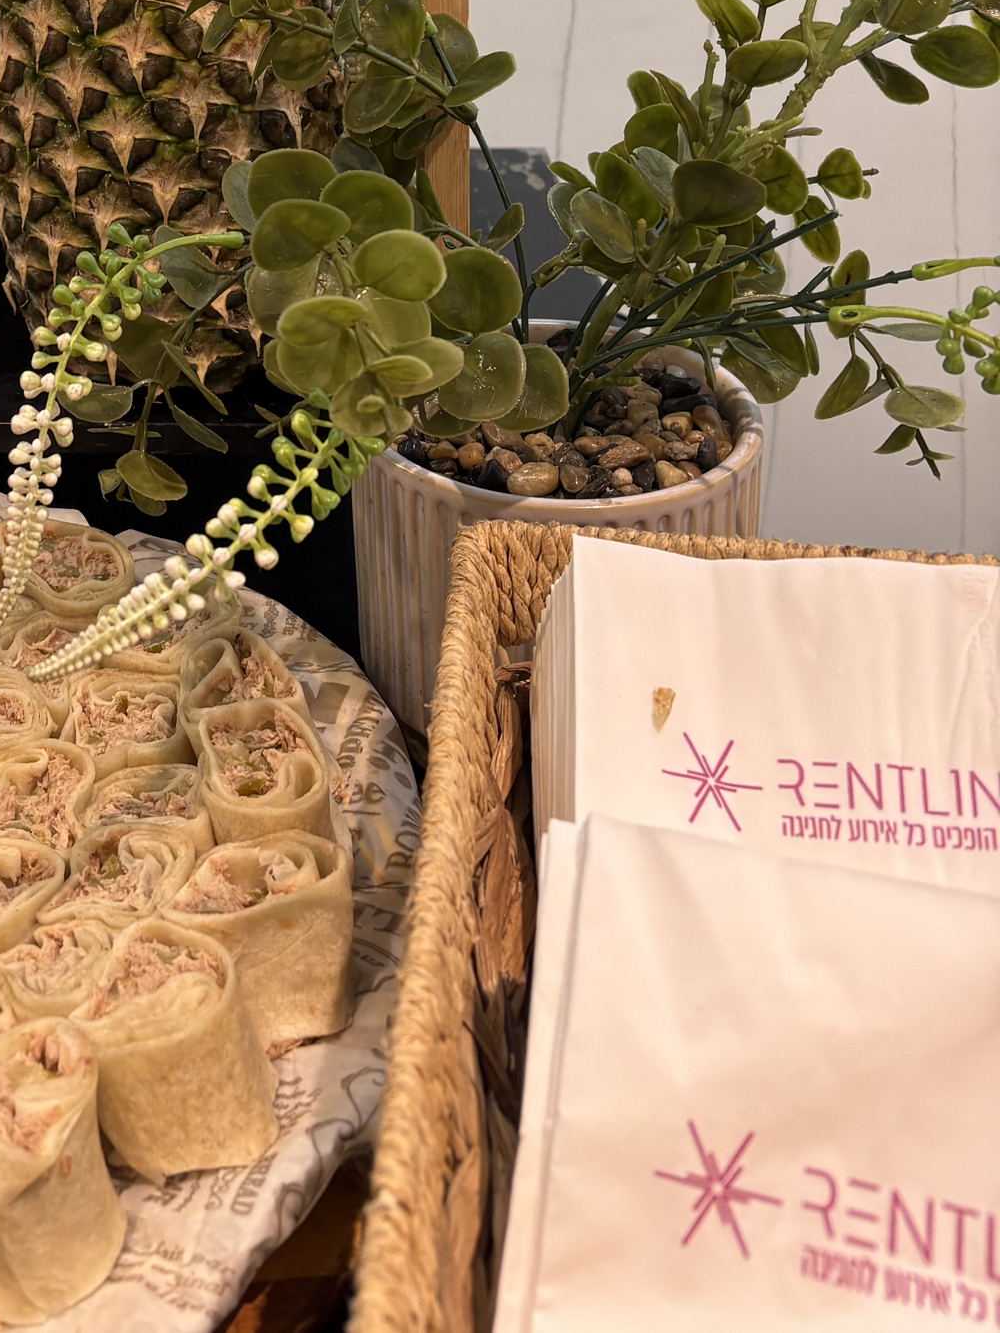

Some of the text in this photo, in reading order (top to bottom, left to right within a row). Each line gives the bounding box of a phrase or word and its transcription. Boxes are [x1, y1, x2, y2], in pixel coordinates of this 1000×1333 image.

[782, 814, 999, 851] הופכים כל אירוע לחגיגה
